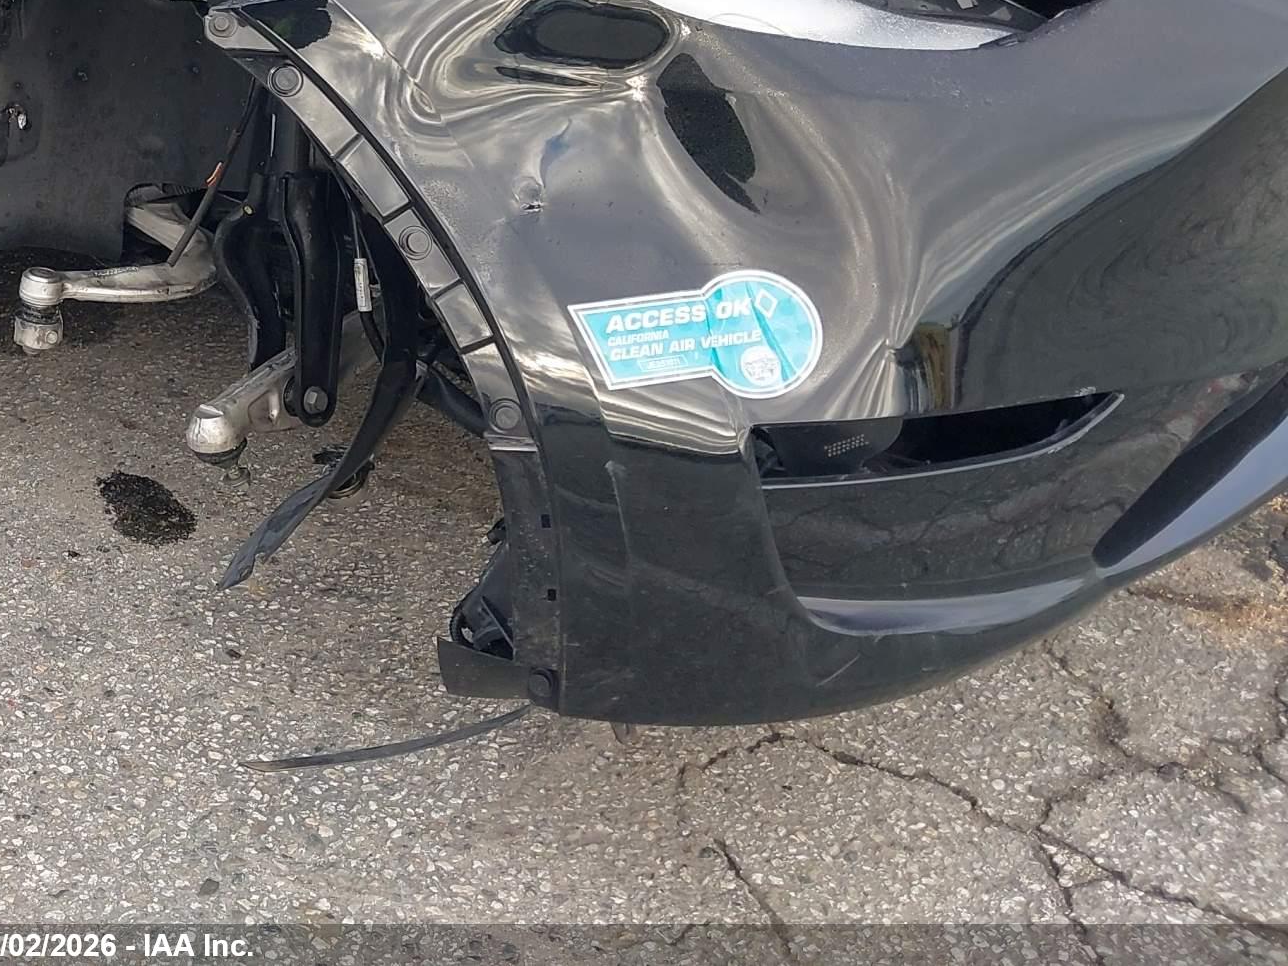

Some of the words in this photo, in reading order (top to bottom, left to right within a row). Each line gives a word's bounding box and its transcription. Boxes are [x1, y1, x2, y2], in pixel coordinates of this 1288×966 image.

[606, 305, 706, 334] ACCESS
[716, 297, 751, 319] OK
[608, 329, 669, 347] CALIFORNIA
[609, 340, 663, 362] CLEAN
[668, 338, 696, 353] AIR
[701, 329, 762, 349] VEHICLE
